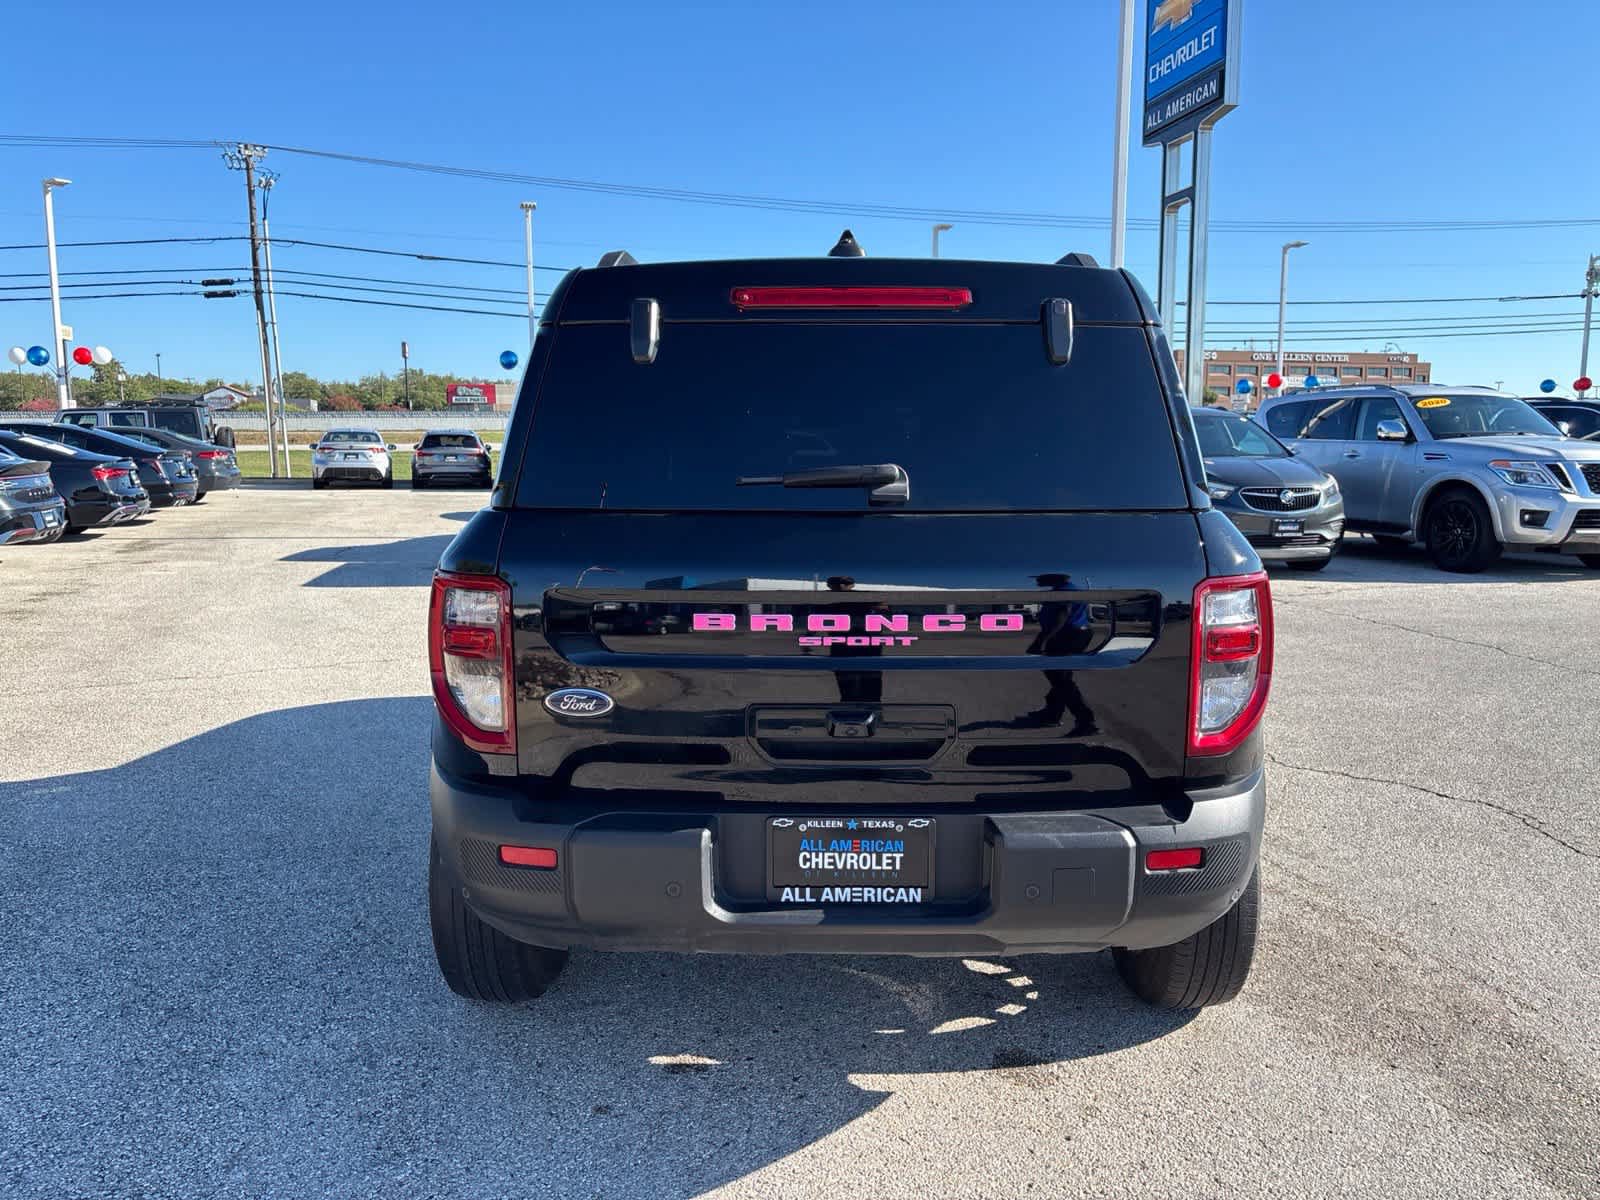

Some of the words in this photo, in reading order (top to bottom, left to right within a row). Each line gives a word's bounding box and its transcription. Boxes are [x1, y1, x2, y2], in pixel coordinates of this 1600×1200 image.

[1149, 25, 1217, 83] CHEVROLET
[1147, 111, 1163, 129] ALL
[1165, 79, 1217, 120] AMERICAN
[1252, 352, 1272, 361] ONE
[1274, 353, 1312, 361] LLEEN
[1315, 354, 1349, 363] CENTER
[693, 613, 1024, 632] BRONCO
[798, 636, 918, 647] SPORT
[560, 694, 598, 711] Ford
[807, 820, 843, 828] KILLEEN
[863, 820, 895, 828] TEXAS
[800, 839, 827, 852] ALL
[829, 839, 904, 853] AMERICAN
[798, 851, 904, 870] CHEVROLET
[780, 887, 816, 902] ALL
[820, 887, 921, 903] AMERICAN
